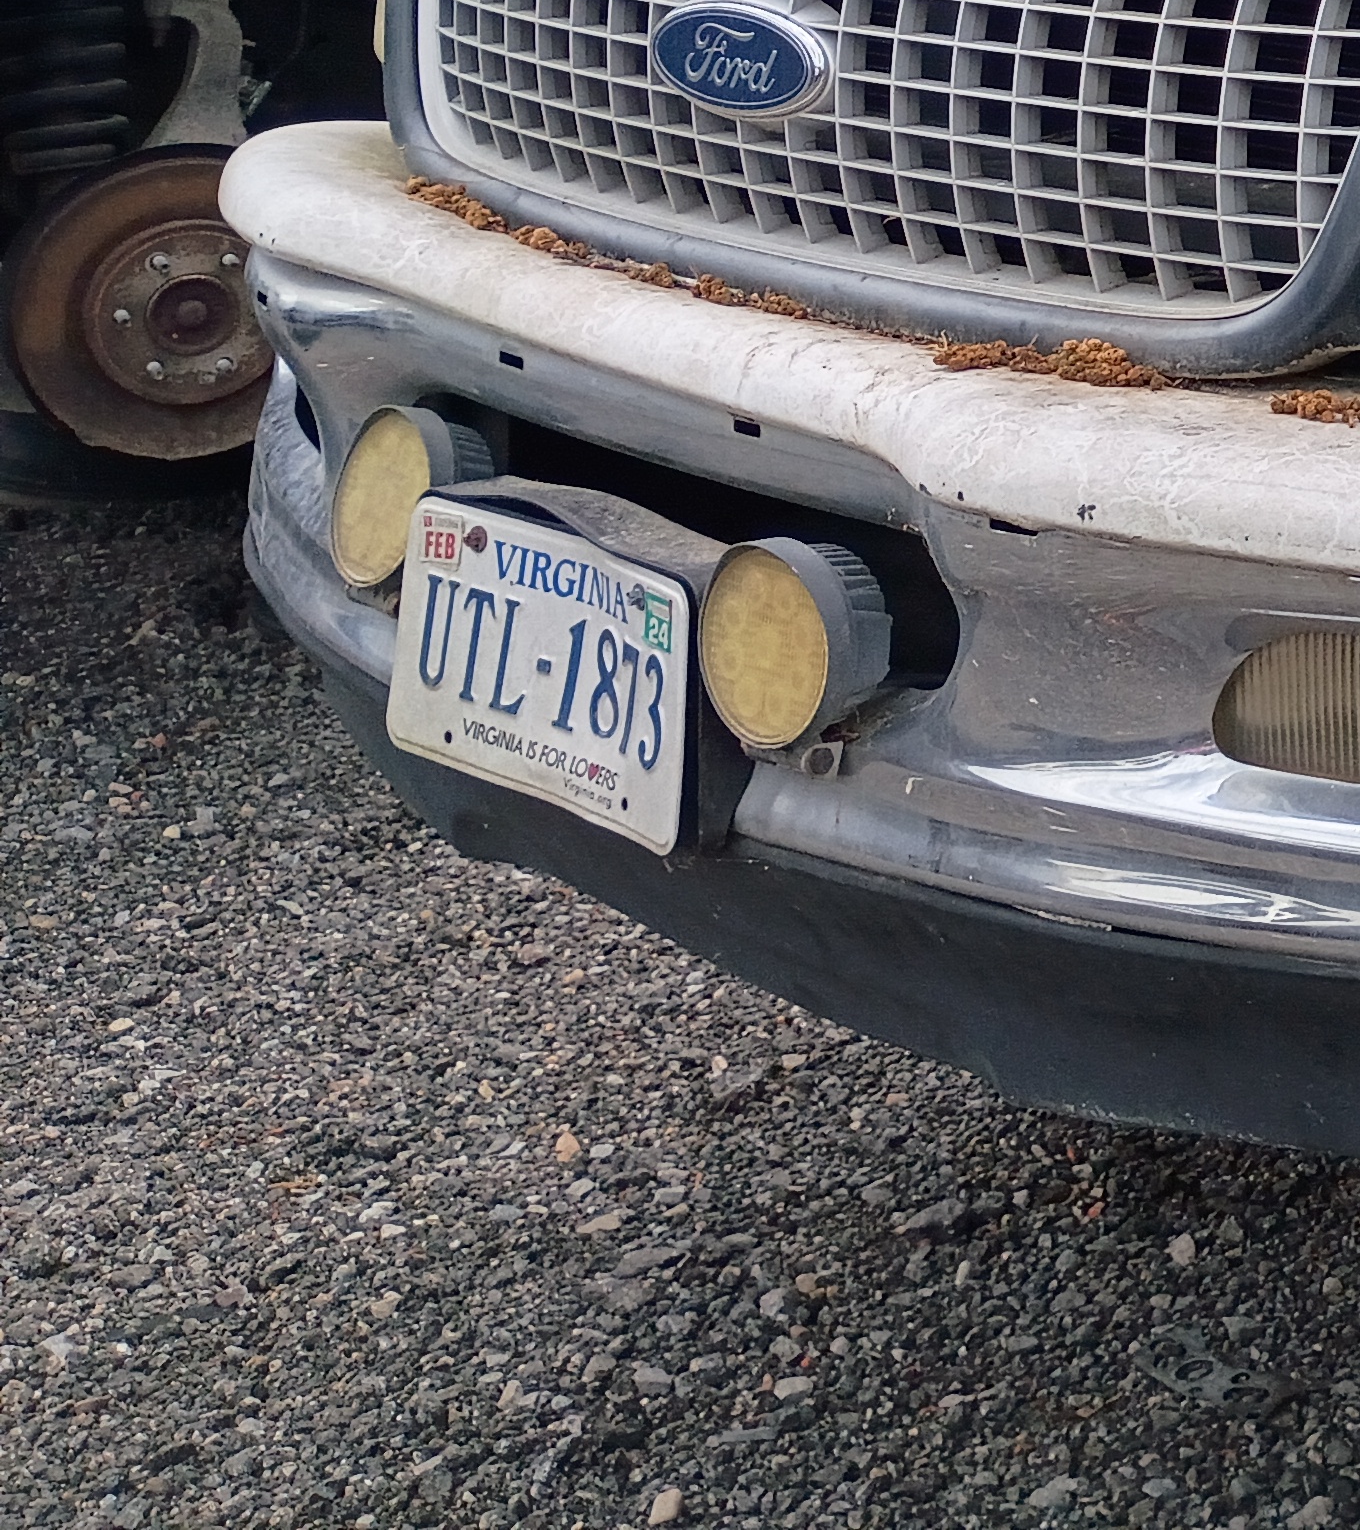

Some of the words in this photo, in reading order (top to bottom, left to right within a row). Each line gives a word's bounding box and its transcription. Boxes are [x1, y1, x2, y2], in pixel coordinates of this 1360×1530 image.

[685, 22, 777, 94] Ford
[425, 531, 456, 560] FEB
[494, 540, 629, 624] VIRGINIA
[648, 617, 669, 649] 24
[419, 575, 664, 770] UTL-1873
[463, 717, 523, 756] VIRGINIA
[526, 740, 537, 760] IS
[540, 745, 567, 771] FOR
